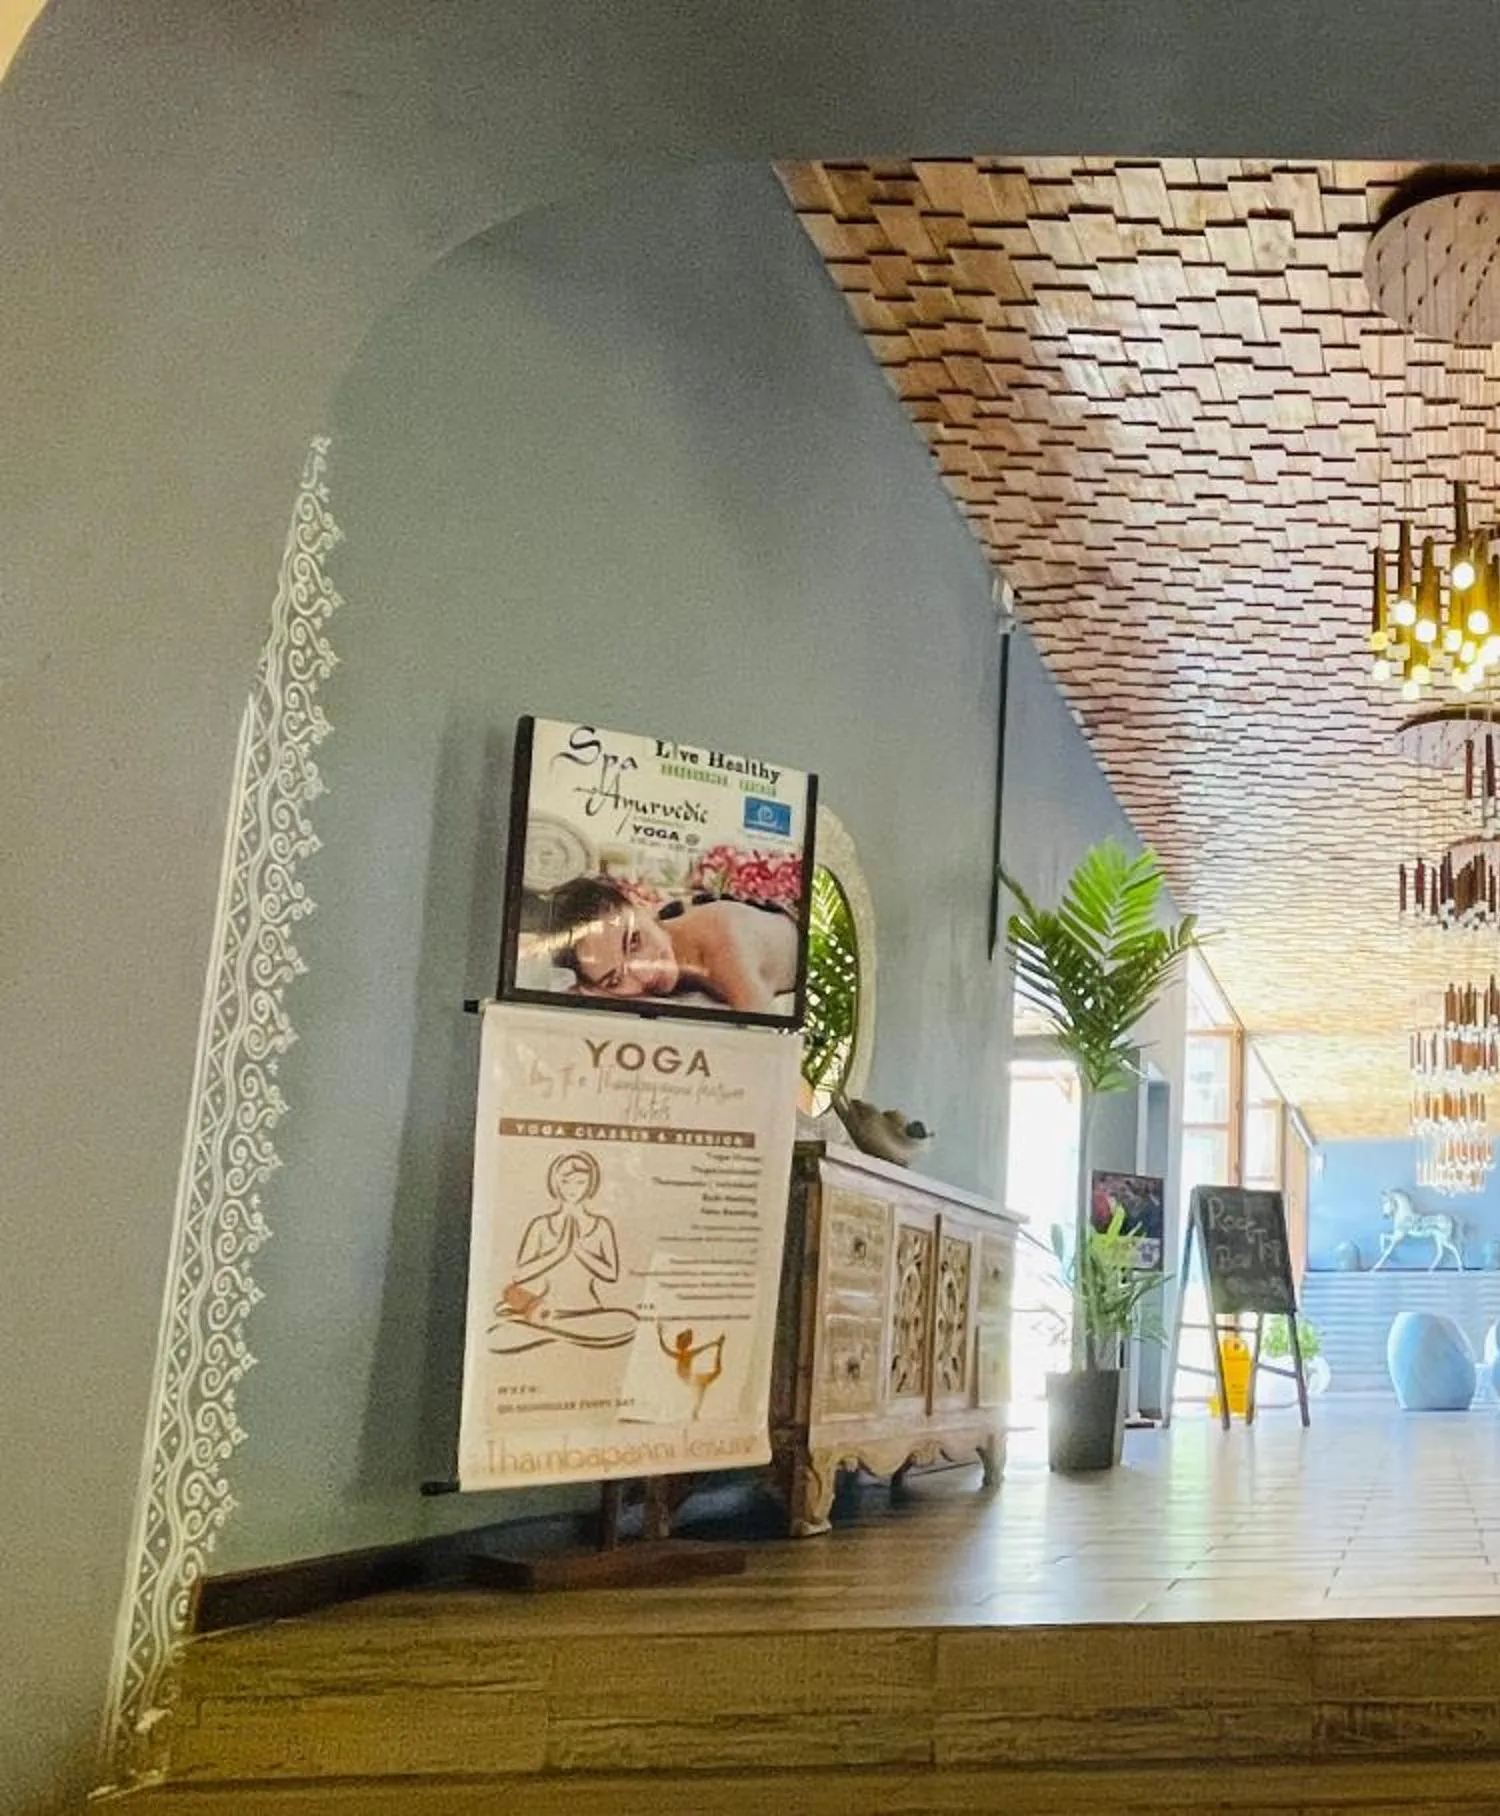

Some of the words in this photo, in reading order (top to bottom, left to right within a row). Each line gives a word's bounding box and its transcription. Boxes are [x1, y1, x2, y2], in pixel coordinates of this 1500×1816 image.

[550, 726, 640, 785] Spa
[655, 738, 699, 765] Live
[707, 750, 782, 785] Healthy
[631, 823, 681, 842] YOGA
[583, 1038, 712, 1078] YOGA
[515, 1122, 564, 1138] YOGA
[574, 1126, 650, 1143] CLASSES
